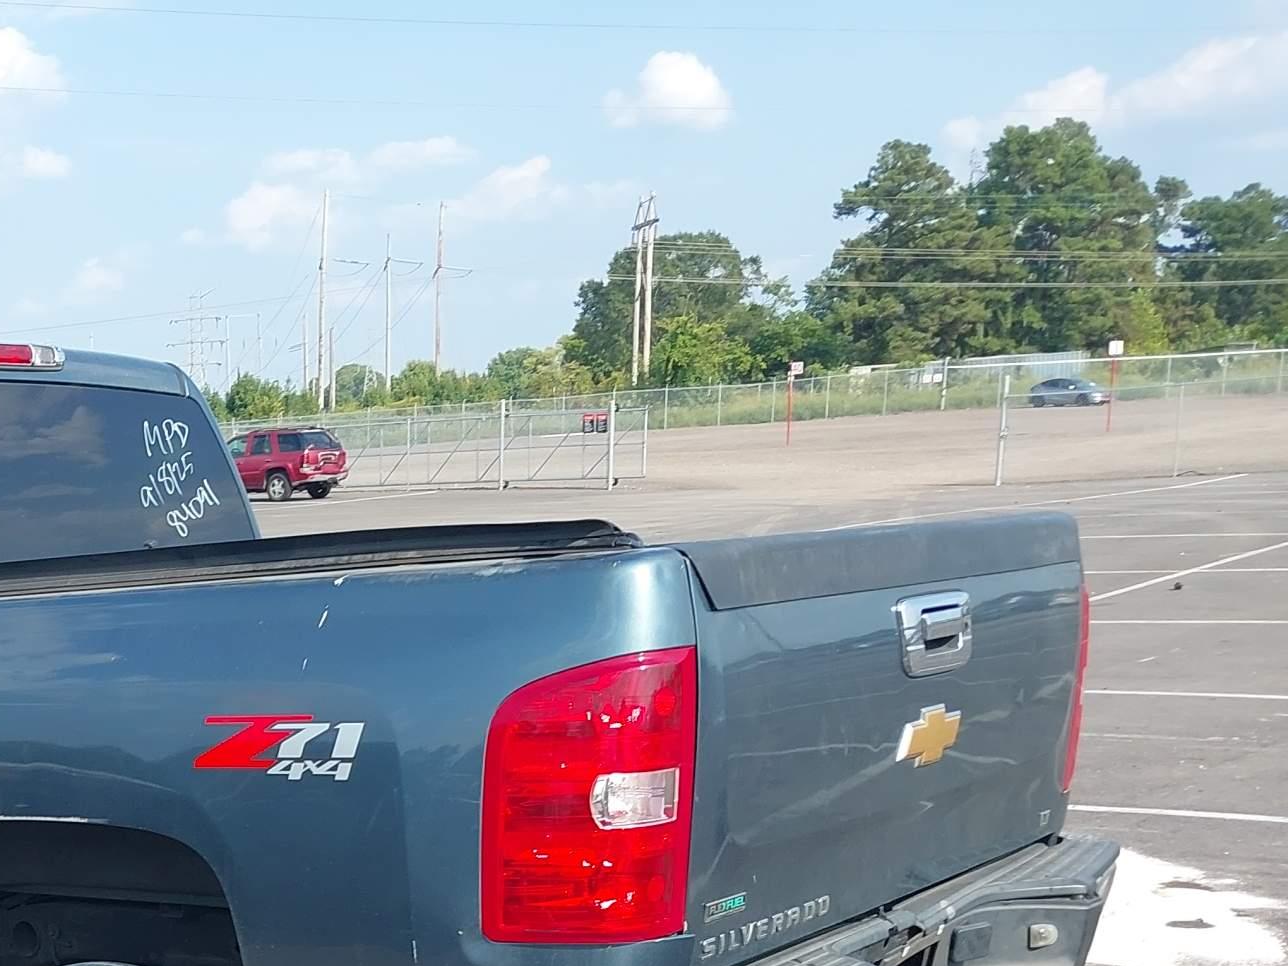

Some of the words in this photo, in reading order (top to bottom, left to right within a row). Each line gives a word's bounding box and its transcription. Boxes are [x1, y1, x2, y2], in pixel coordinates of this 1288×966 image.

[143, 419, 189, 457] MPD
[194, 714, 365, 769] Z71
[700, 895, 831, 960] SILVERADO
